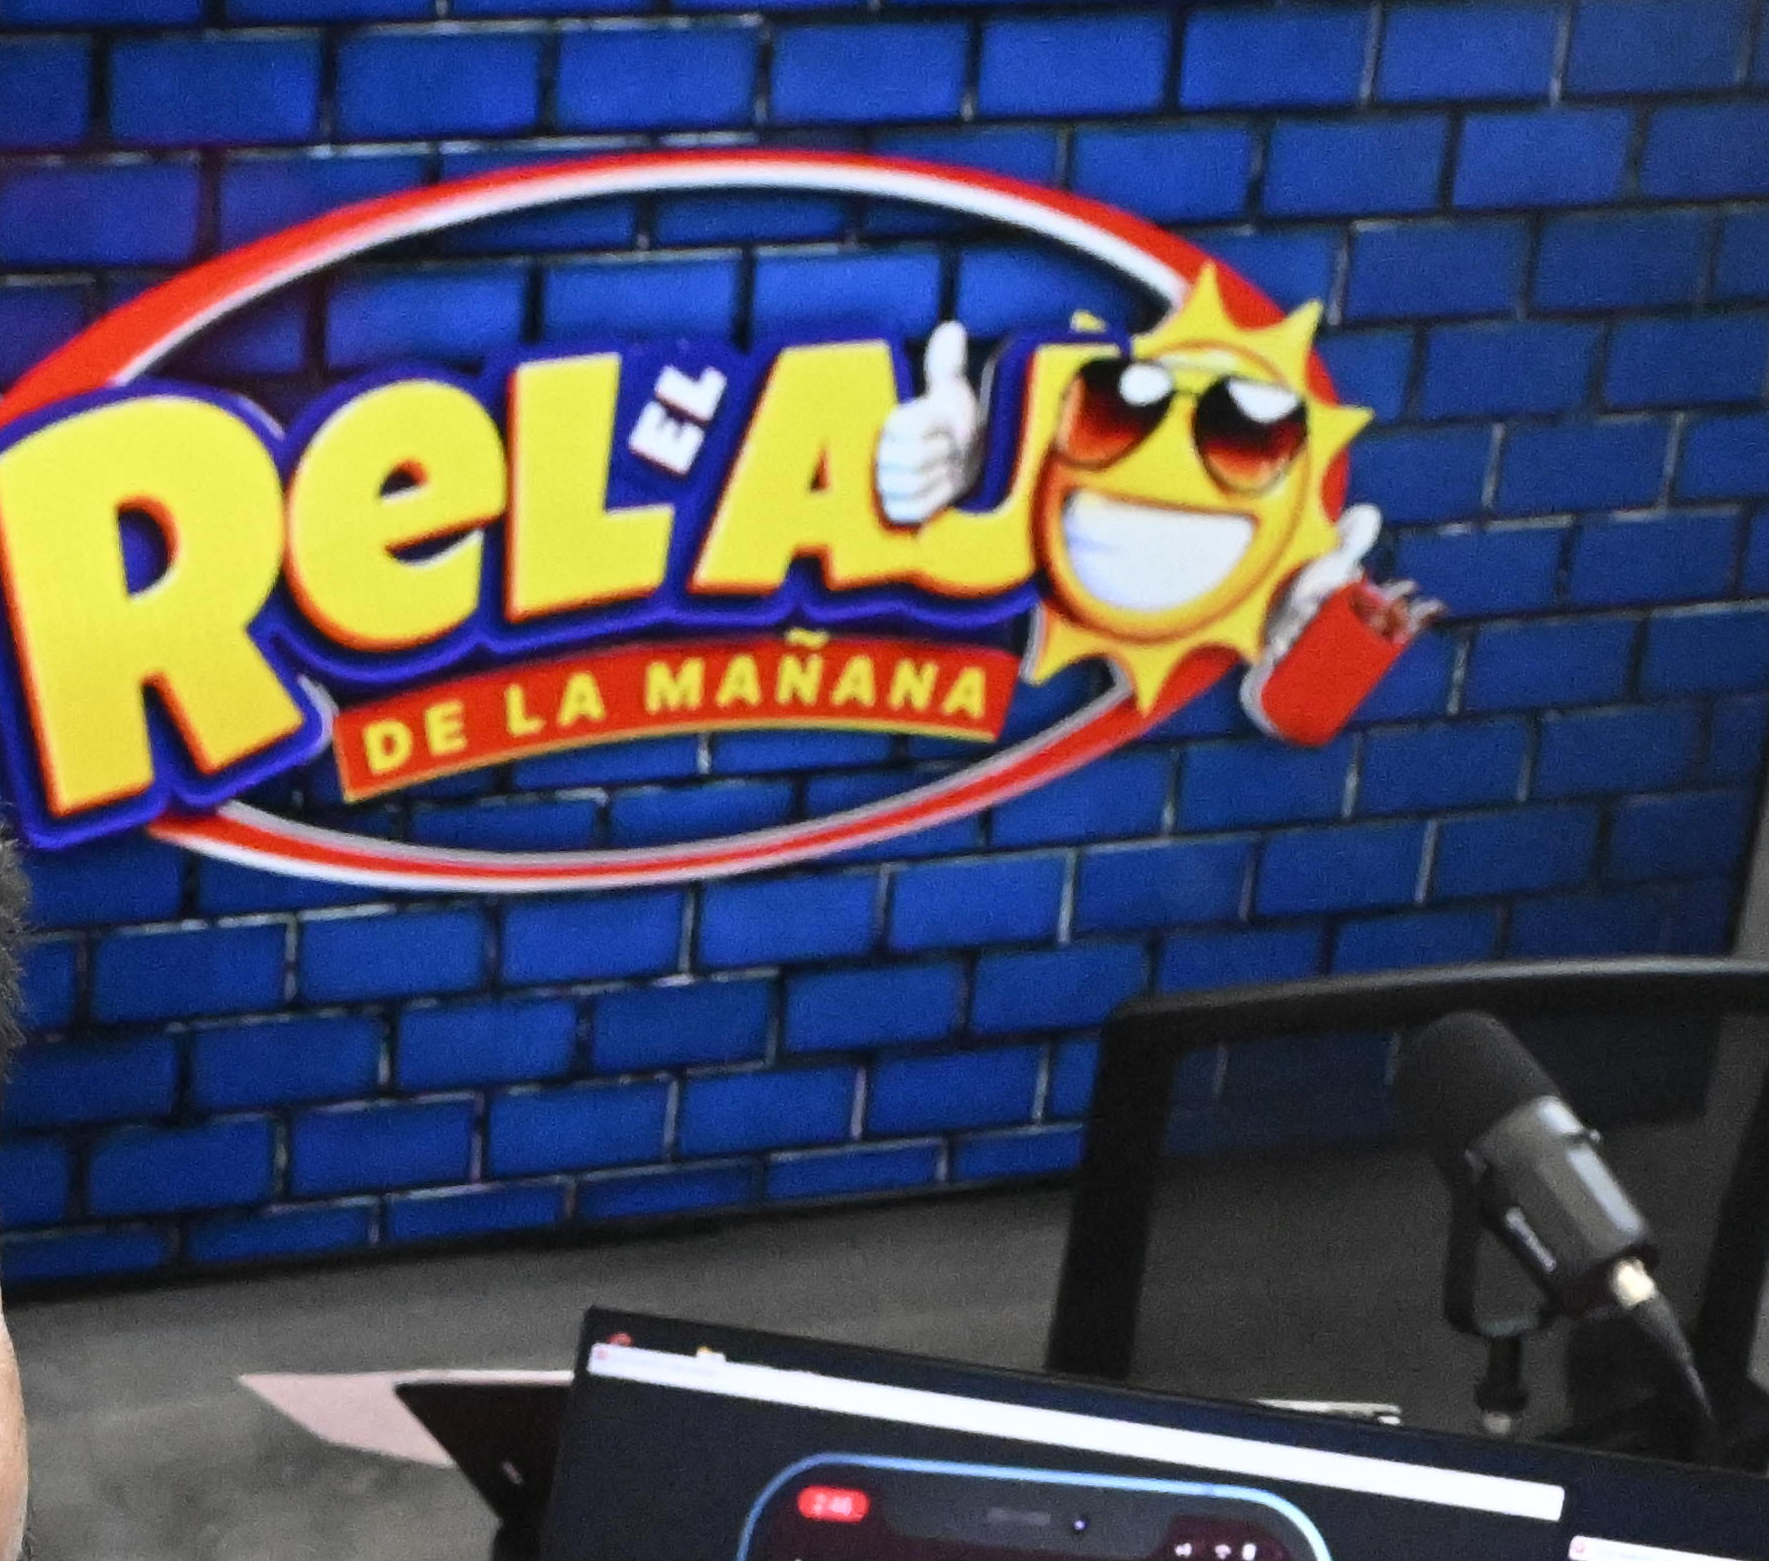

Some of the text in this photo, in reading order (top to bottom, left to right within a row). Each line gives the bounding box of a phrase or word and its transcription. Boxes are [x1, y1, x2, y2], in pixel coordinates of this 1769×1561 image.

[631, 363, 727, 479] EL
[364, 631, 988, 777] DE LA MAÑANA
